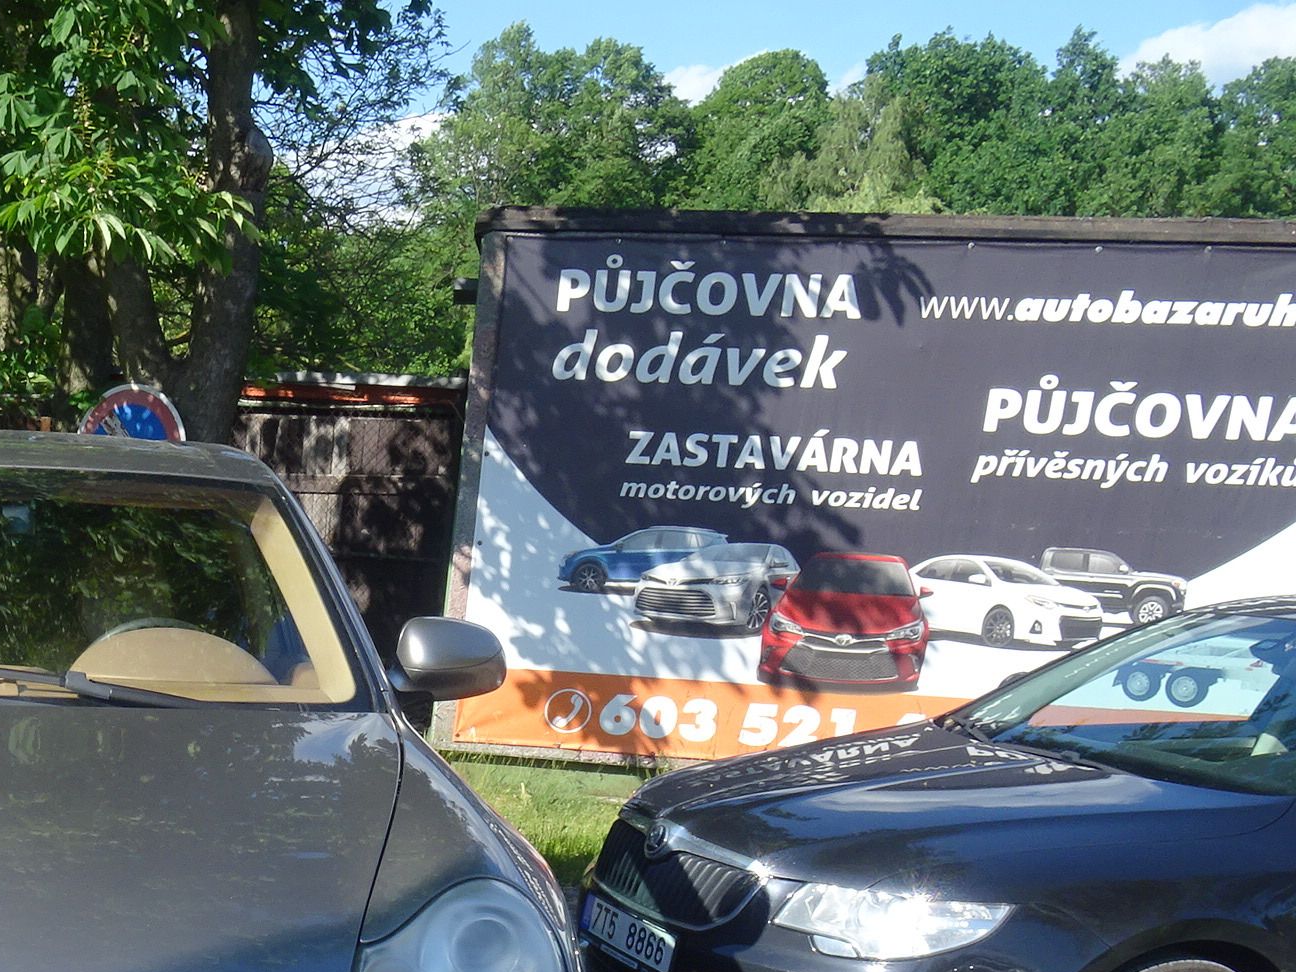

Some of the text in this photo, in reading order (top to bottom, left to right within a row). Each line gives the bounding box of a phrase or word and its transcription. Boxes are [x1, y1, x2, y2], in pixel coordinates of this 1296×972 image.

[556, 254, 861, 319] PŮJČOVNA
[552, 328, 848, 390] dodávek
[625, 429, 923, 477] ZASTAVÁRNA
[970, 449, 1169, 489] přívěsných
[619, 480, 923, 511] motorových vozidel
[599, 693, 858, 747] 603 521
[625, 922, 666, 965] 8866
